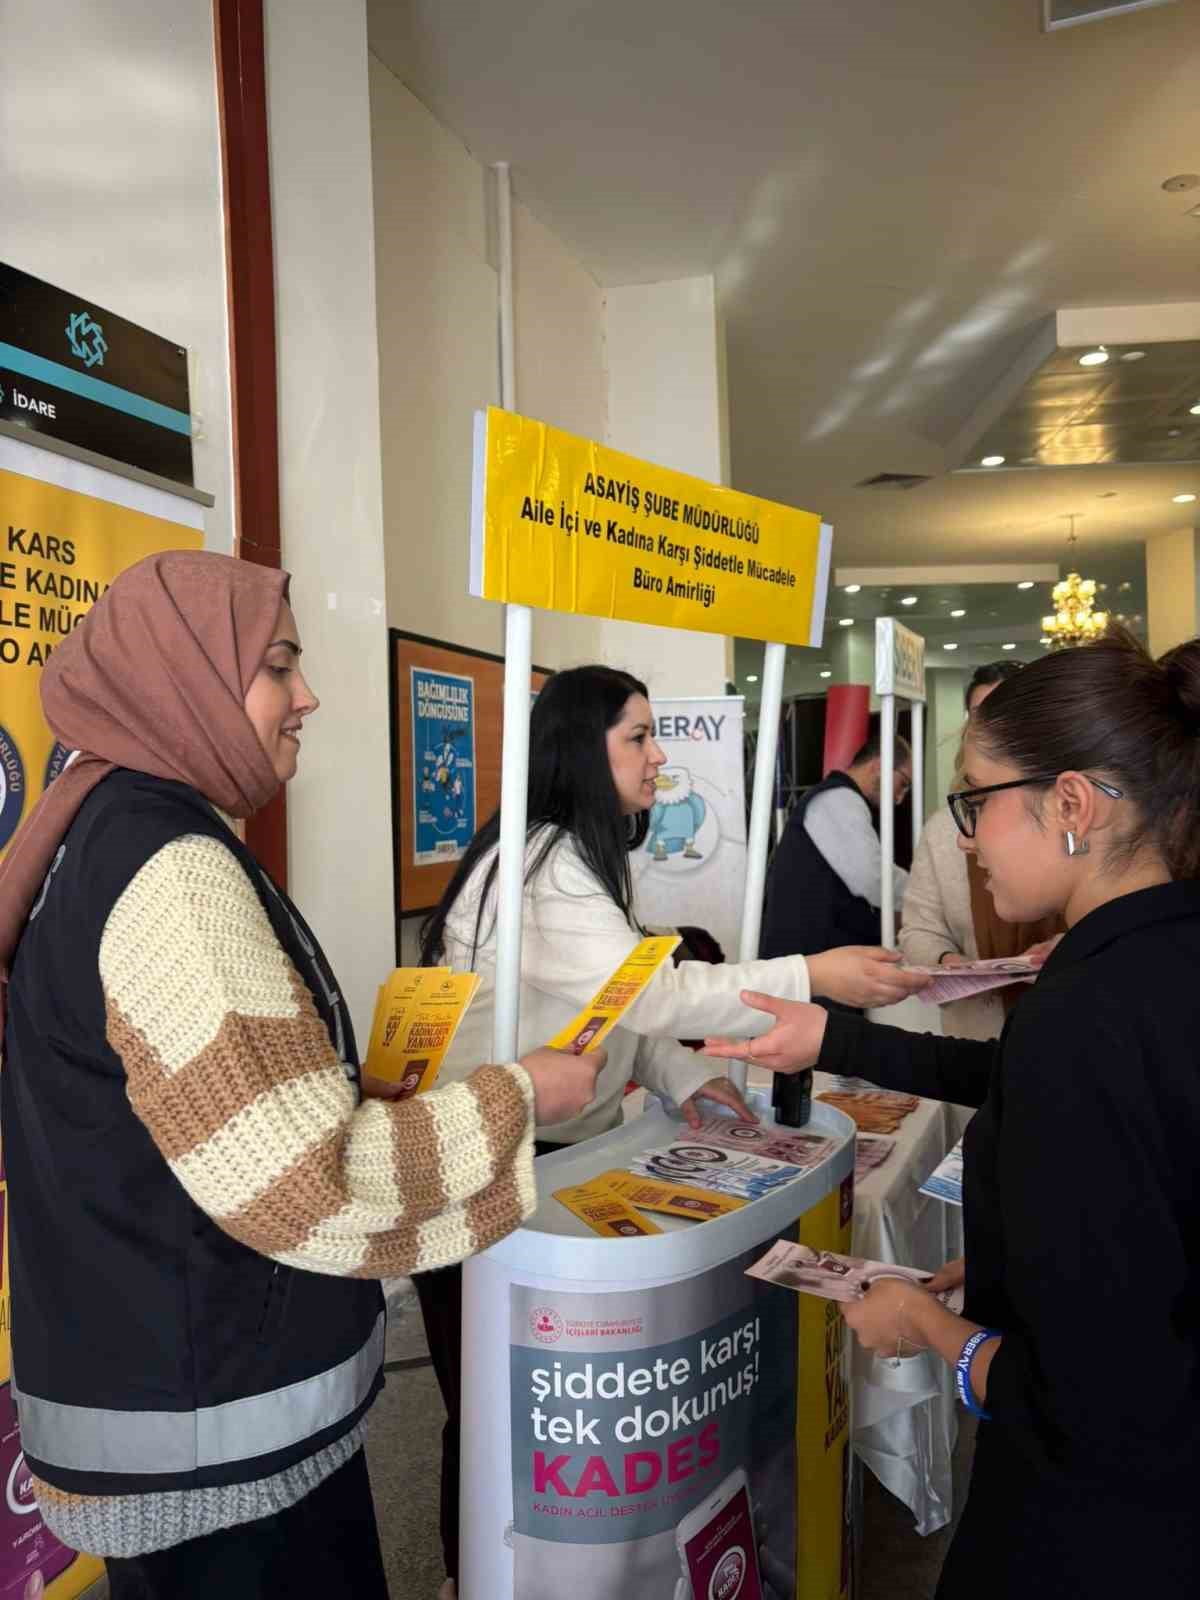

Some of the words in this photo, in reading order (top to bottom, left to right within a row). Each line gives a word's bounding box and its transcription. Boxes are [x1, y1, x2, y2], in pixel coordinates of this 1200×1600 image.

[13, 388, 57, 419] İDARE
[583, 471, 640, 513] ASAYİŞ
[643, 492, 679, 521] ŞUBE
[682, 502, 760, 545] MÜDÜRLÜĞÜ
[7, 525, 76, 566] KARS
[520, 496, 554, 528] Aile
[559, 500, 580, 537] İçi
[584, 519, 602, 538] ve
[606, 521, 654, 553] Kadına
[657, 535, 691, 567] Karşı
[693, 544, 744, 576] Şiddetle
[746, 558, 797, 588] Mücadele
[25, 567, 110, 604] KADIN
[633, 567, 664, 593] Büro
[665, 579, 717, 609] Amirliği
[651, 714, 726, 742] ERAY
[530, 1355, 691, 1403] şiddete
[700, 1316, 760, 1374] karşı
[531, 1406, 601, 1446] tek
[614, 1351, 760, 1443] dokunuş!
[532, 1422, 721, 1499] KADES
